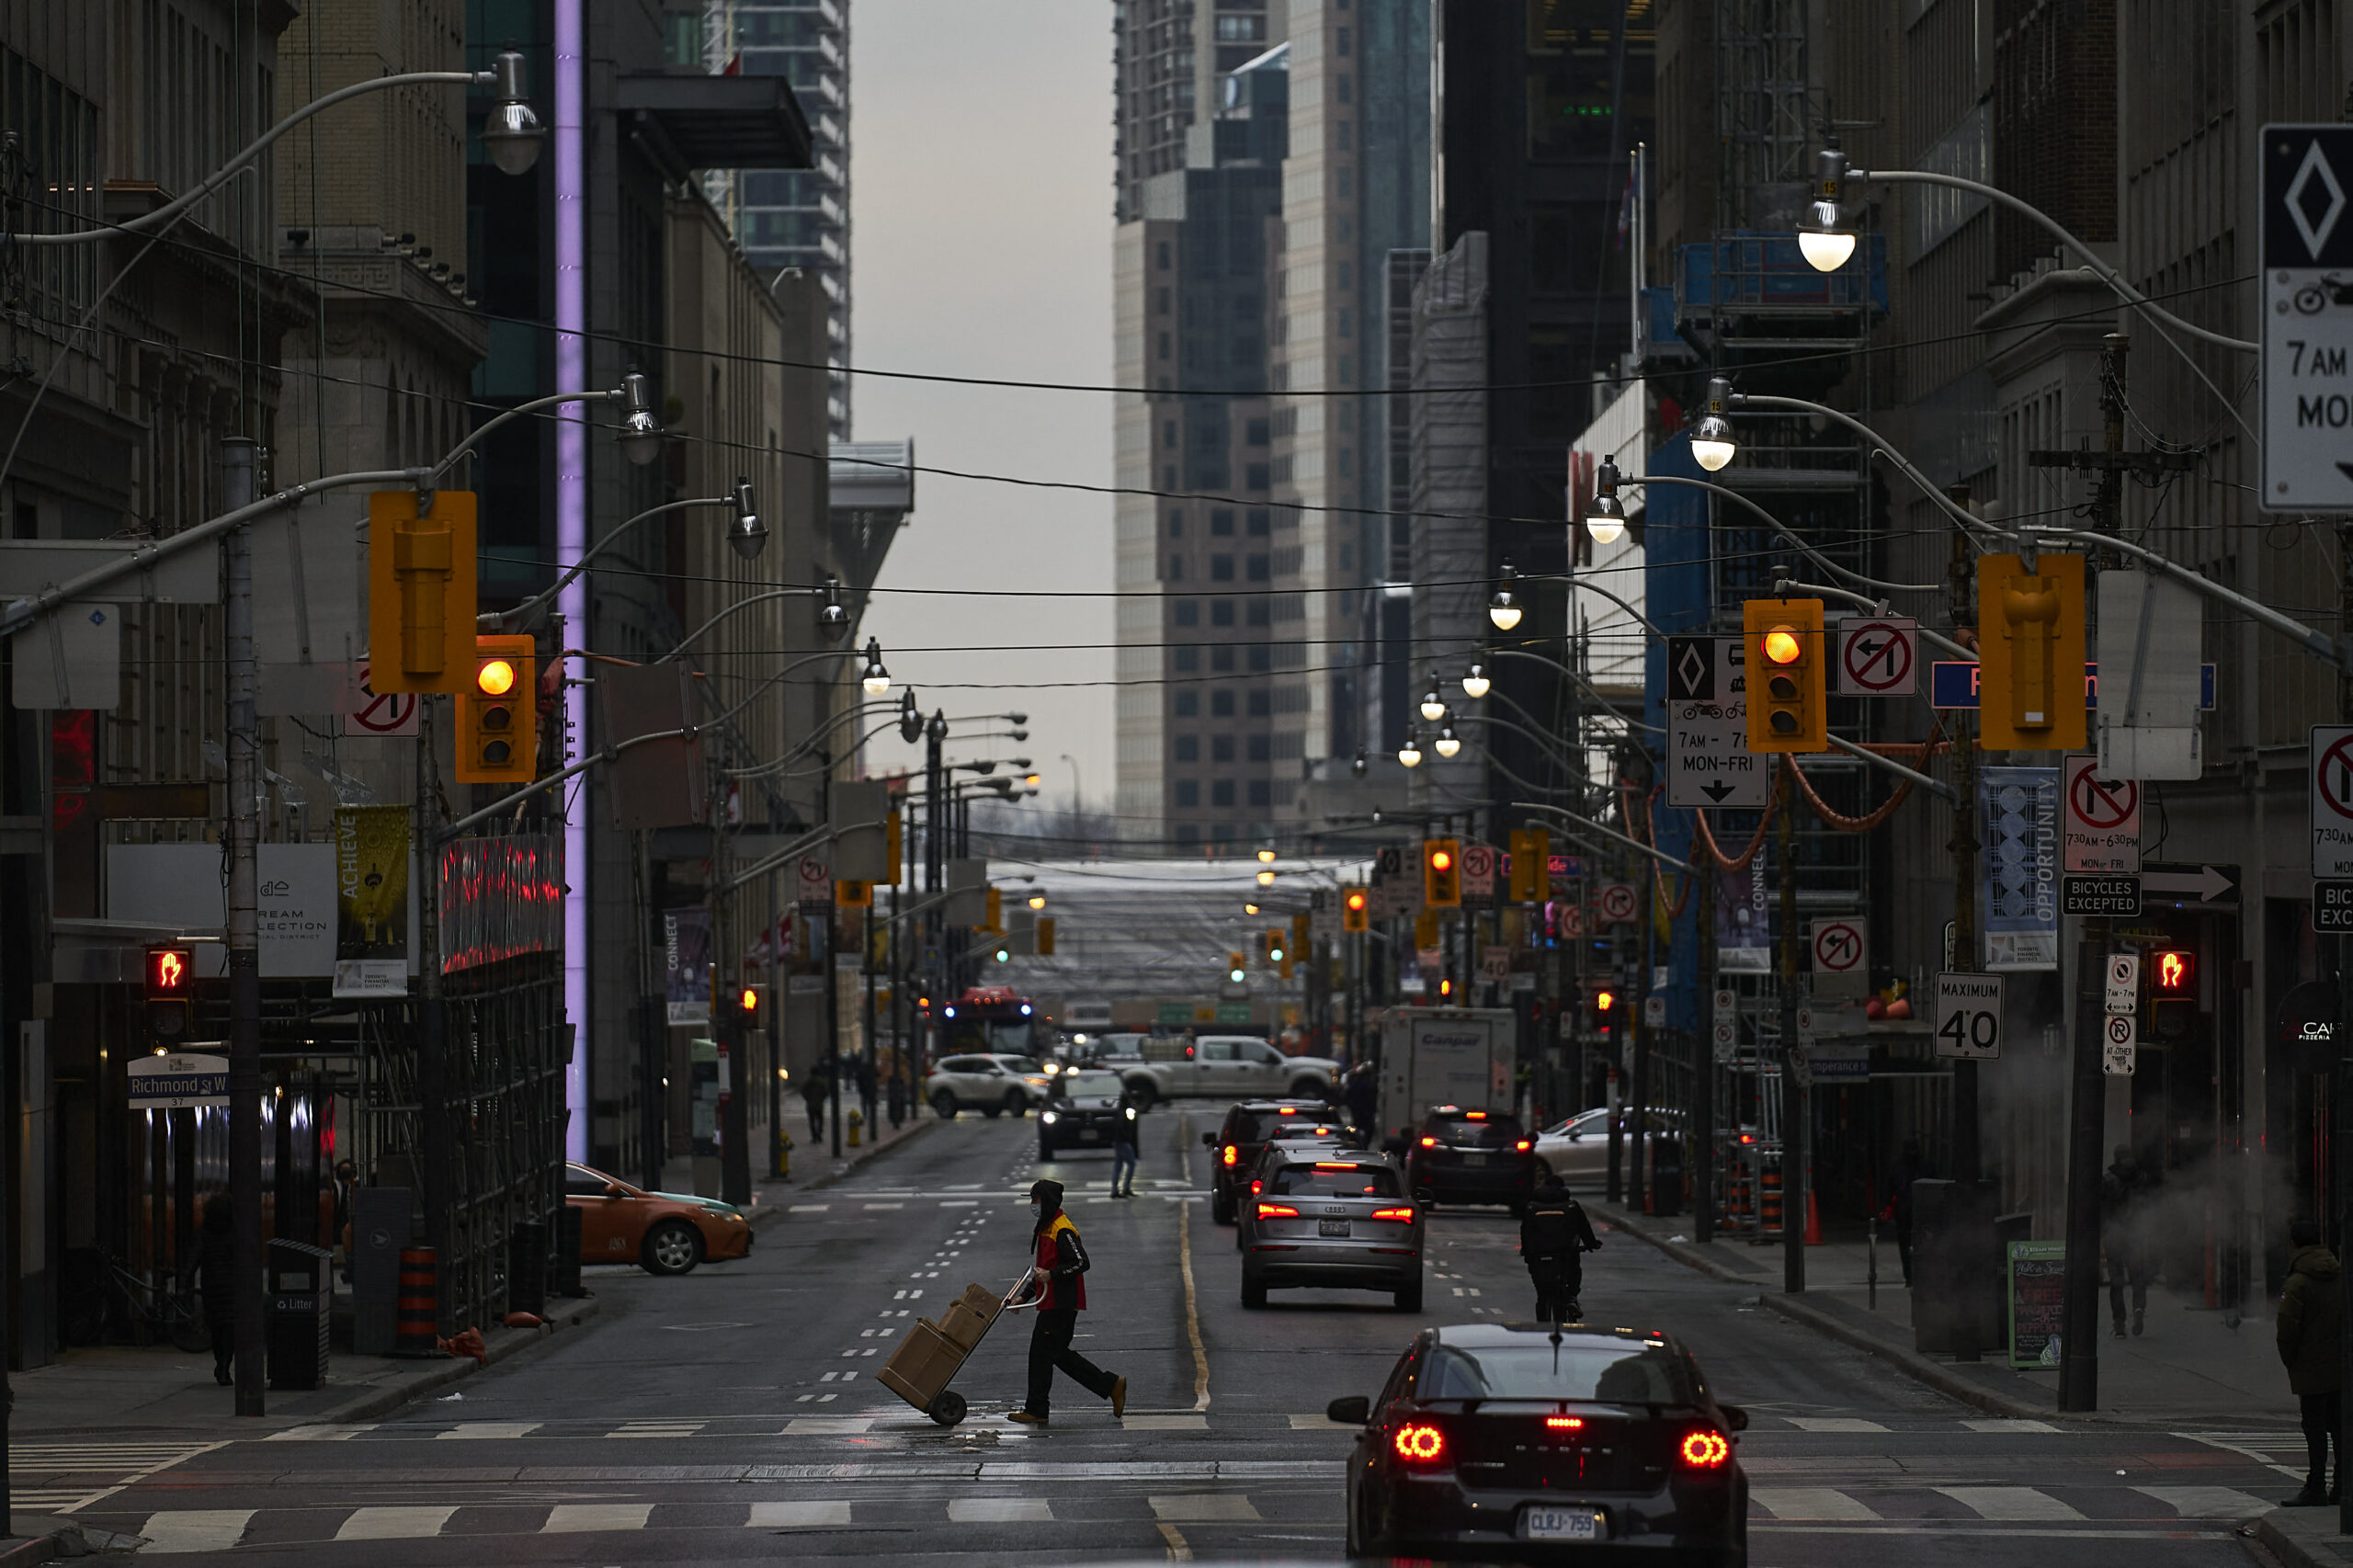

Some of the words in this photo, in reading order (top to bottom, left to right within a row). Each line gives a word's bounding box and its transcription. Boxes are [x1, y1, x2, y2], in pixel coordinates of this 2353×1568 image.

[2298, 394, 2353, 427] MO
[1683, 756, 1754, 772] MON-FRI
[340, 814, 358, 899] ACHIEVE
[2037, 778, 2056, 923] OPPORTUNITY
[2080, 858, 2099, 869] MON
[2110, 859, 2124, 869] FRI
[2071, 881, 2132, 895] BICYCLES
[2067, 897, 2136, 911] EXCEPTED
[2325, 888, 2353, 905] BIC
[257, 910, 303, 918] REAM
[257, 922, 326, 931] LECTION
[664, 915, 679, 971] CONNECT
[1941, 983, 1998, 998] MAXIMUM
[1938, 1010, 1997, 1049] 40
[131, 1076, 198, 1094] Richmond
[201, 1078, 212, 1092] St
[214, 1075, 226, 1092] W
[171, 1097, 184, 1107] 37
[2023, 1288, 2063, 1303] FREE
[289, 1297, 313, 1310] Litter
